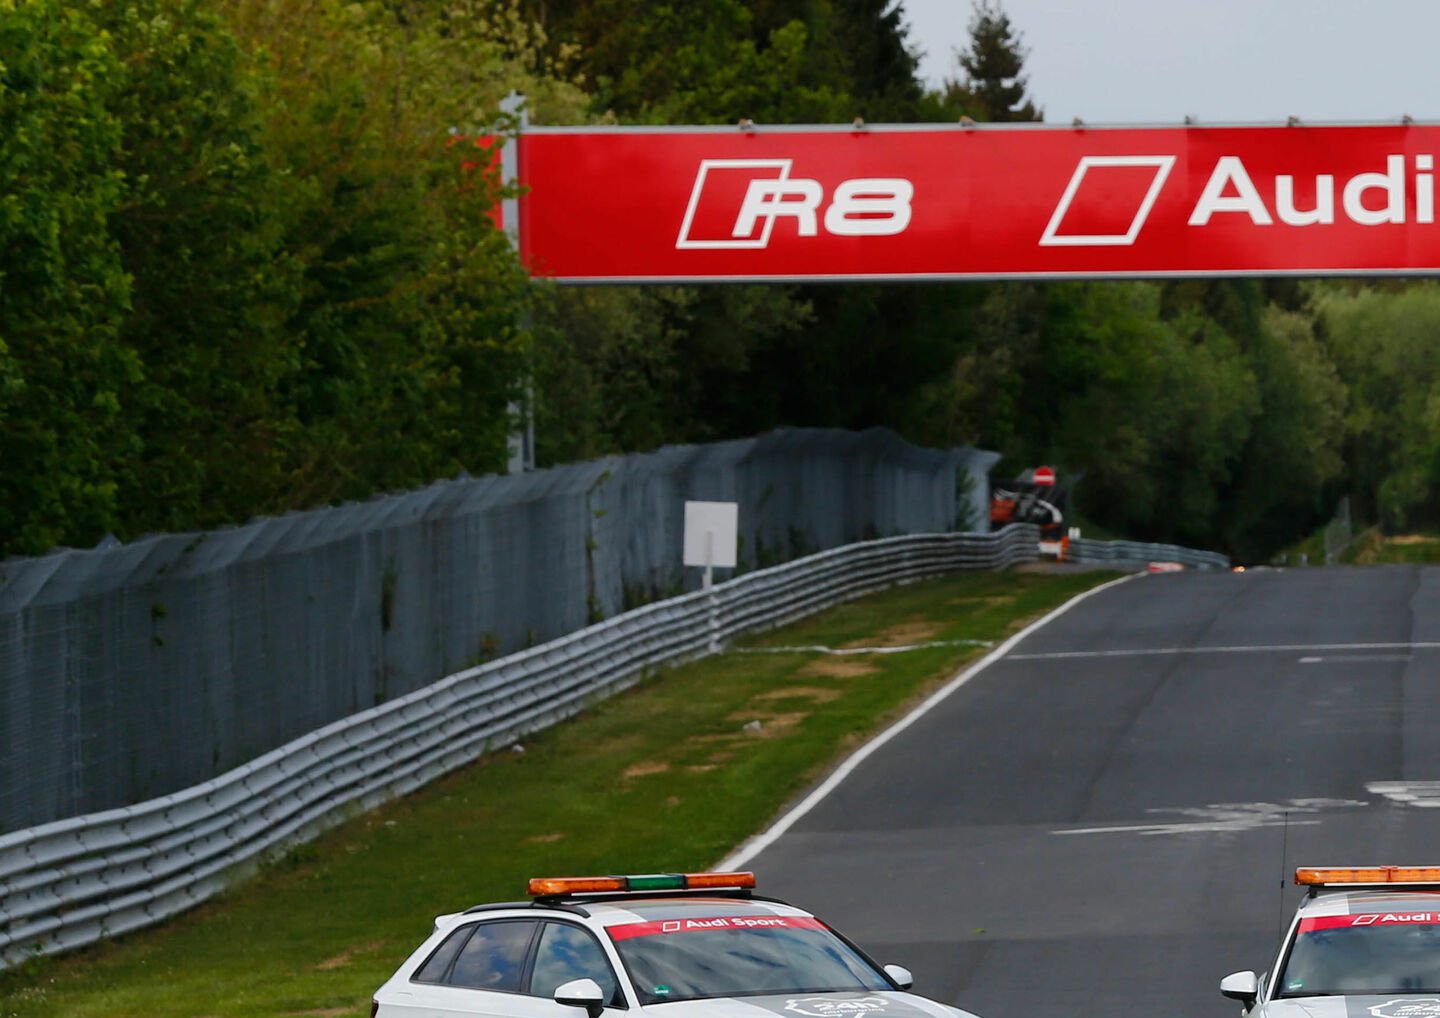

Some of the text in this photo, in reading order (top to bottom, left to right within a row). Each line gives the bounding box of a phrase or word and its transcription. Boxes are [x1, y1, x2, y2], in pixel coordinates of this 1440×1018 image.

[732, 178, 914, 237] R8
[1188, 154, 1435, 226] Audi
[686, 917, 787, 928] Audi Sport
[1381, 913, 1431, 922] Audi
